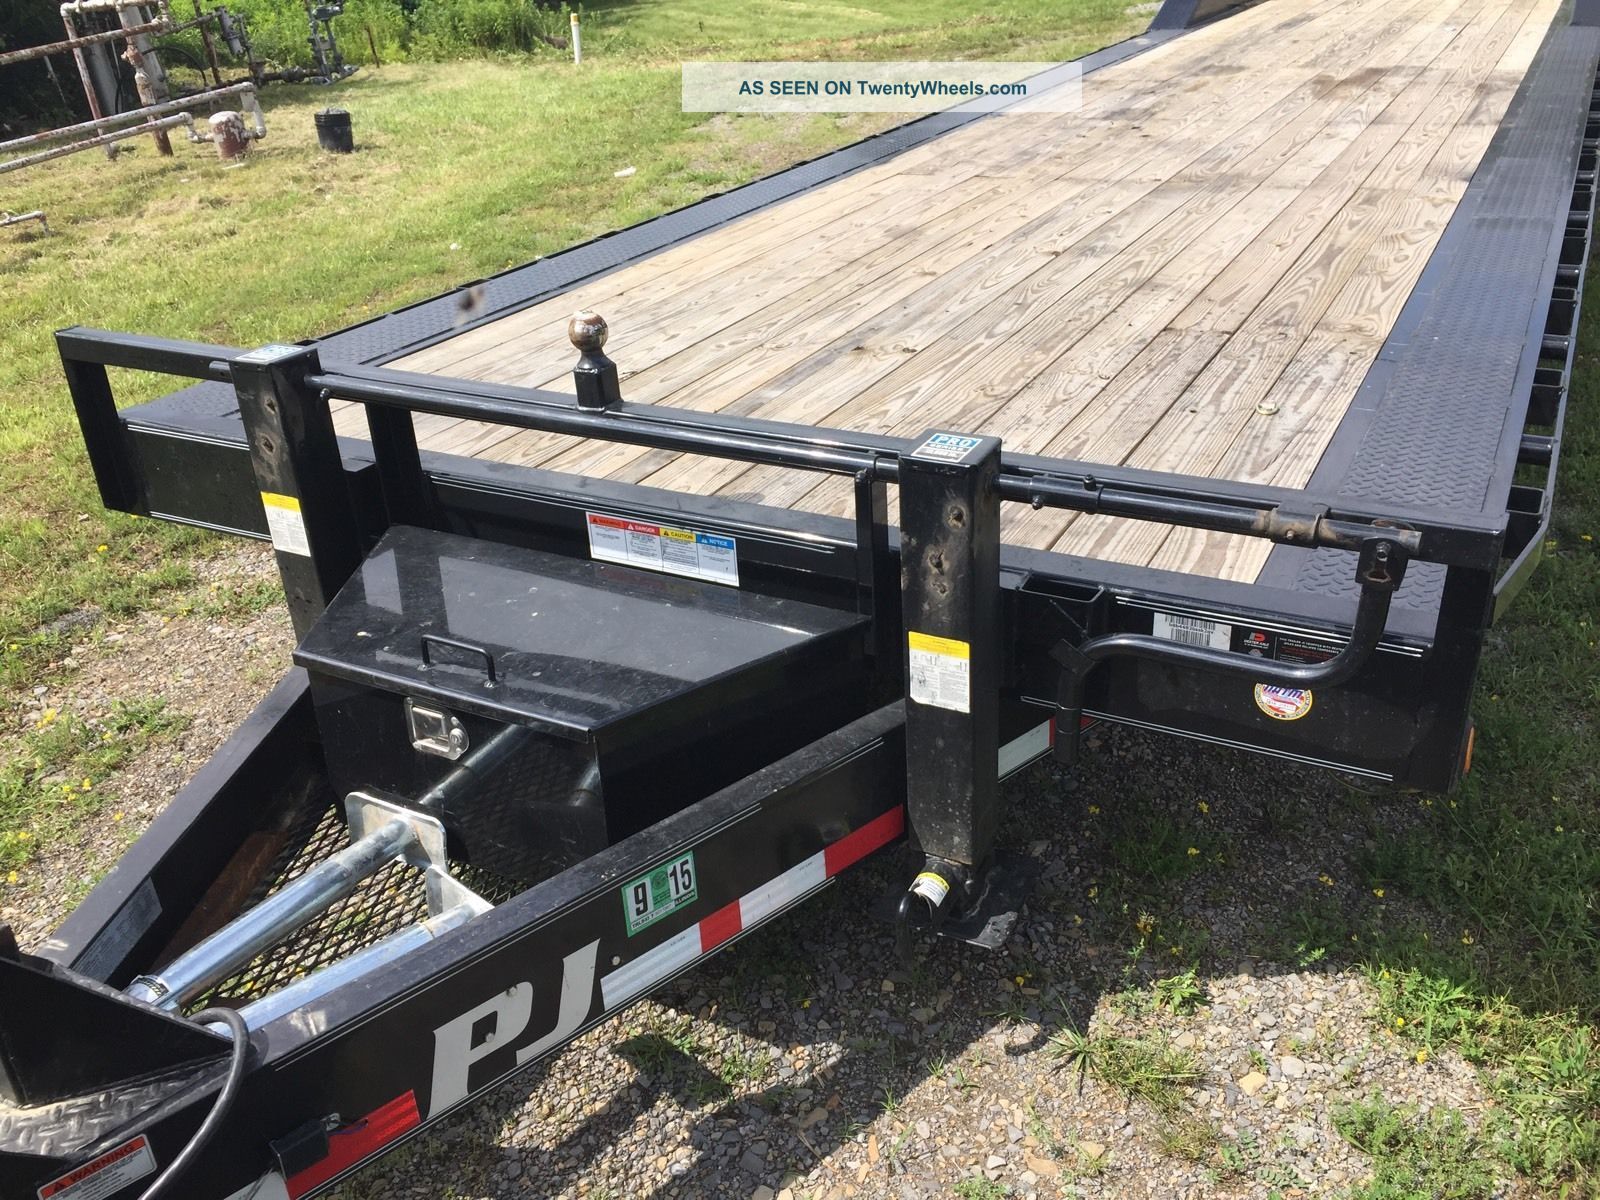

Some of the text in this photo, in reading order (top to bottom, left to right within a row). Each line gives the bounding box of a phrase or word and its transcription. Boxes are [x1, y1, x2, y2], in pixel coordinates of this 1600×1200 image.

[935, 434, 974, 448] PRO
[670, 531, 694, 540] CAUTION
[708, 538, 728, 546] NOTICE
[633, 881, 649, 917] 9
[669, 858, 692, 896] 15
[426, 938, 600, 1121] PJ
[69, 1144, 134, 1183] WARNING
